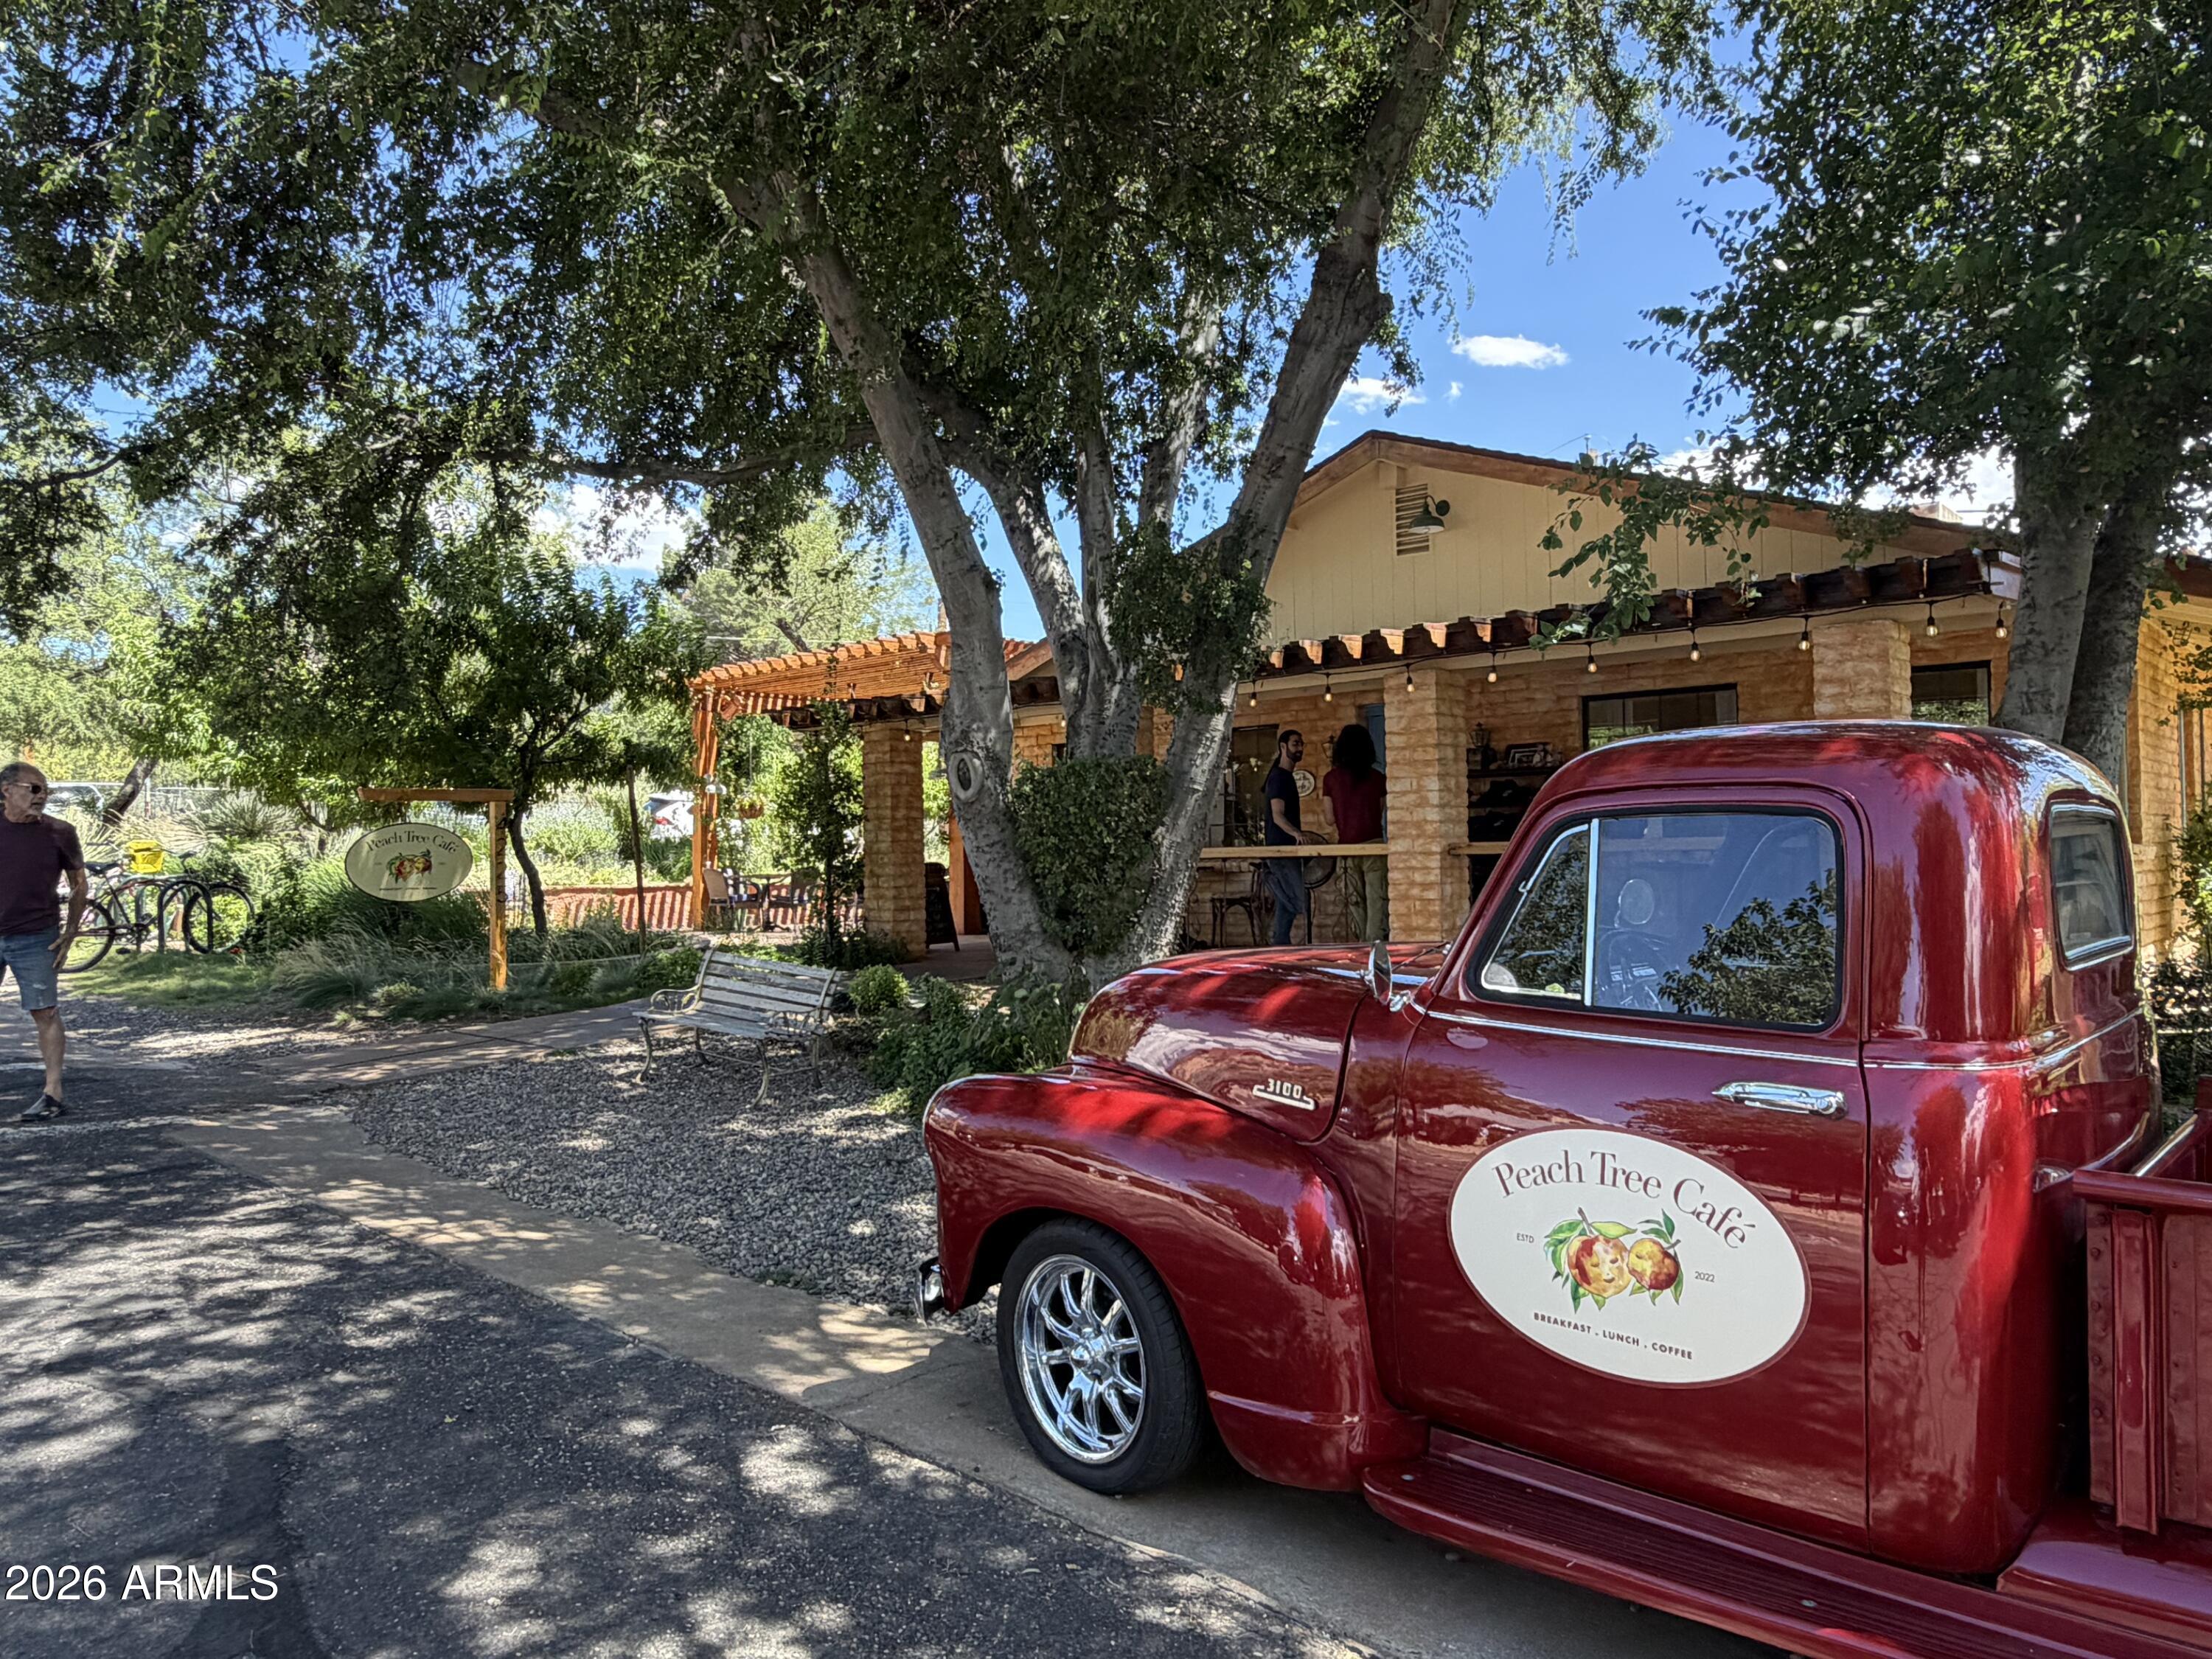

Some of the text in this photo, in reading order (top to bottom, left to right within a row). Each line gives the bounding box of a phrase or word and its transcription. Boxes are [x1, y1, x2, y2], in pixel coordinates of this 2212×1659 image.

[366, 830, 459, 854] Peach Tree Café
[1267, 1078, 1302, 1099] 3100
[1491, 1149, 1756, 1249] Peach Tree Café
[1516, 1232, 1535, 1244] ESTD
[1694, 1270, 1716, 1283] 2022
[1534, 1312, 1694, 1360] BREAKFAST LUNCH COFFEE
